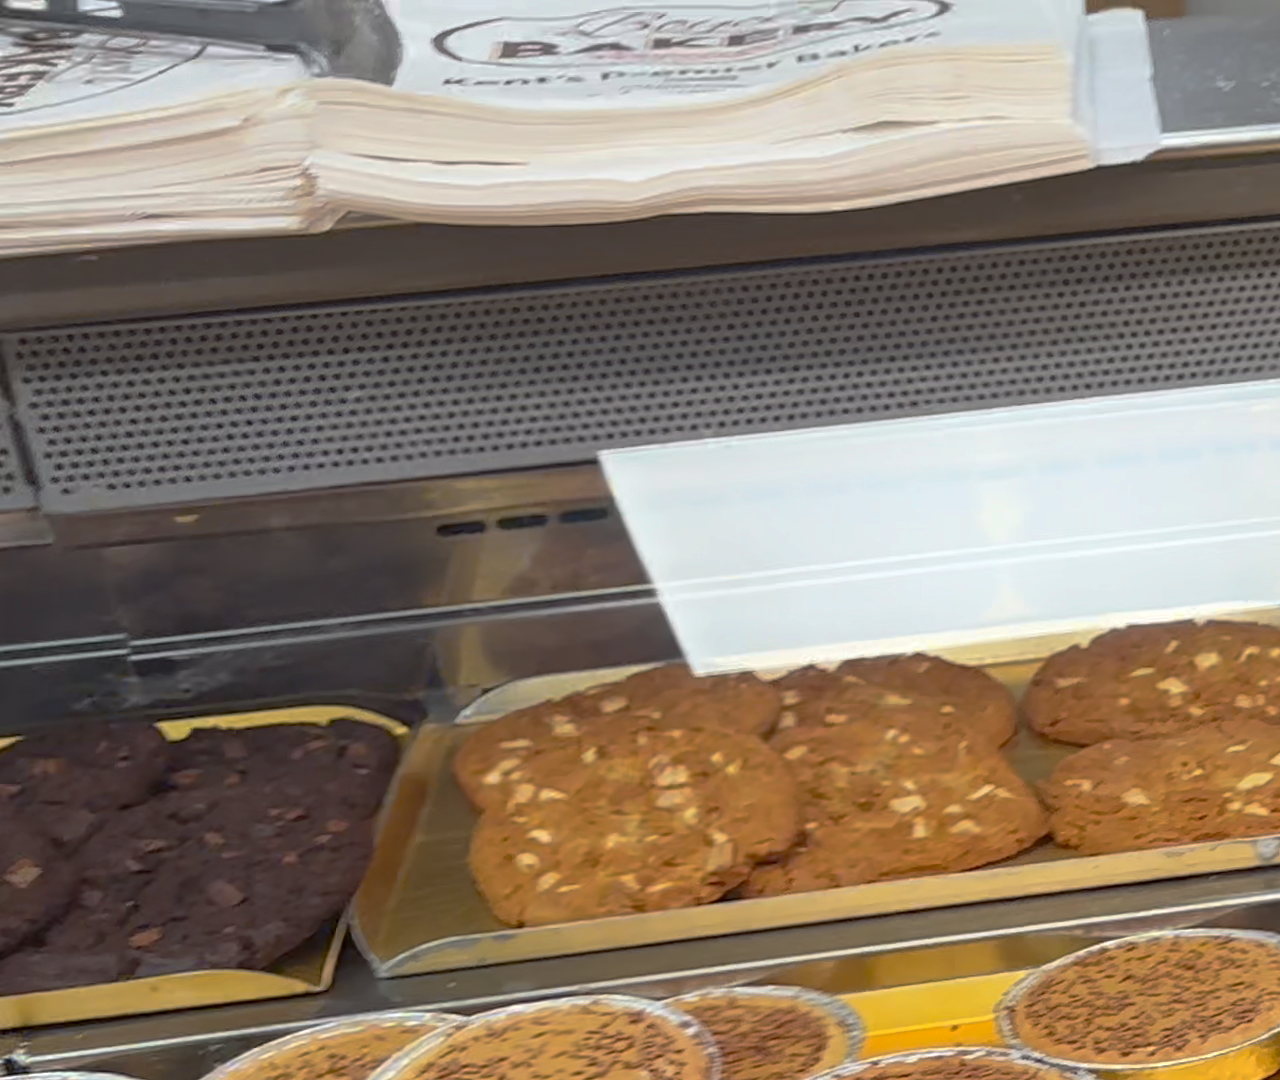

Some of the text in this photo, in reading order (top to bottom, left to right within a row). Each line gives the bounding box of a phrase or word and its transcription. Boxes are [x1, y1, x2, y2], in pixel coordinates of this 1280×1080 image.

[441, 72, 585, 87] Kent's
[600, 59, 783, 82] Premier
[795, 30, 943, 64] Bakers
